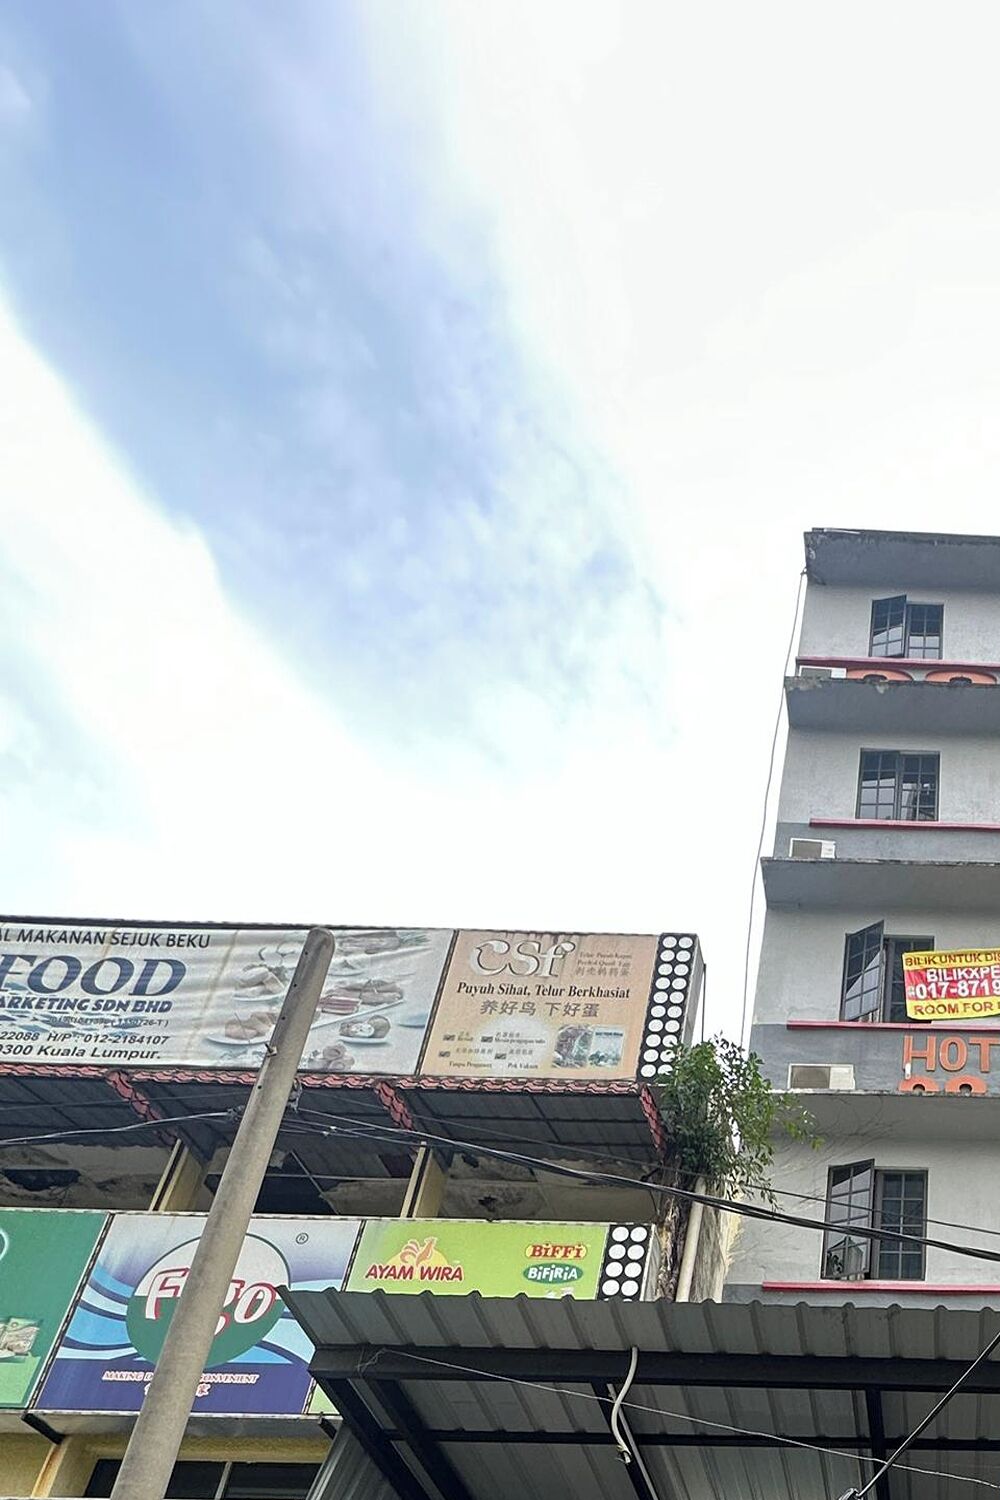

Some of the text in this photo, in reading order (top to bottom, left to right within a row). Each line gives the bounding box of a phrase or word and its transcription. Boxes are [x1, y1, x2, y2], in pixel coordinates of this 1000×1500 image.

[16, 929, 106, 945] MAKANAN
[109, 932, 162, 947] SEJUK
[166, 934, 211, 949] BEKU
[905, 955, 936, 967] BILIK
[939, 953, 982, 964] UNTUK
[456, 981, 630, 999] Puyuh Sihat, Telur Berkhasiat
[92, 999, 131, 1013] SDN
[131, 1001, 173, 1013] BHD
[480, 1000, 600, 1018] 养好鸟 下好蛋
[914, 1003, 959, 1016] ROOM
[963, 1001, 993, 1013] FOR
[83, 1033, 171, 1045] 012-2184107
[37, 1044, 85, 1058] Kuala
[90, 1047, 162, 1061] Lumpur.
[364, 1264, 465, 1282] AYAM WIRA
